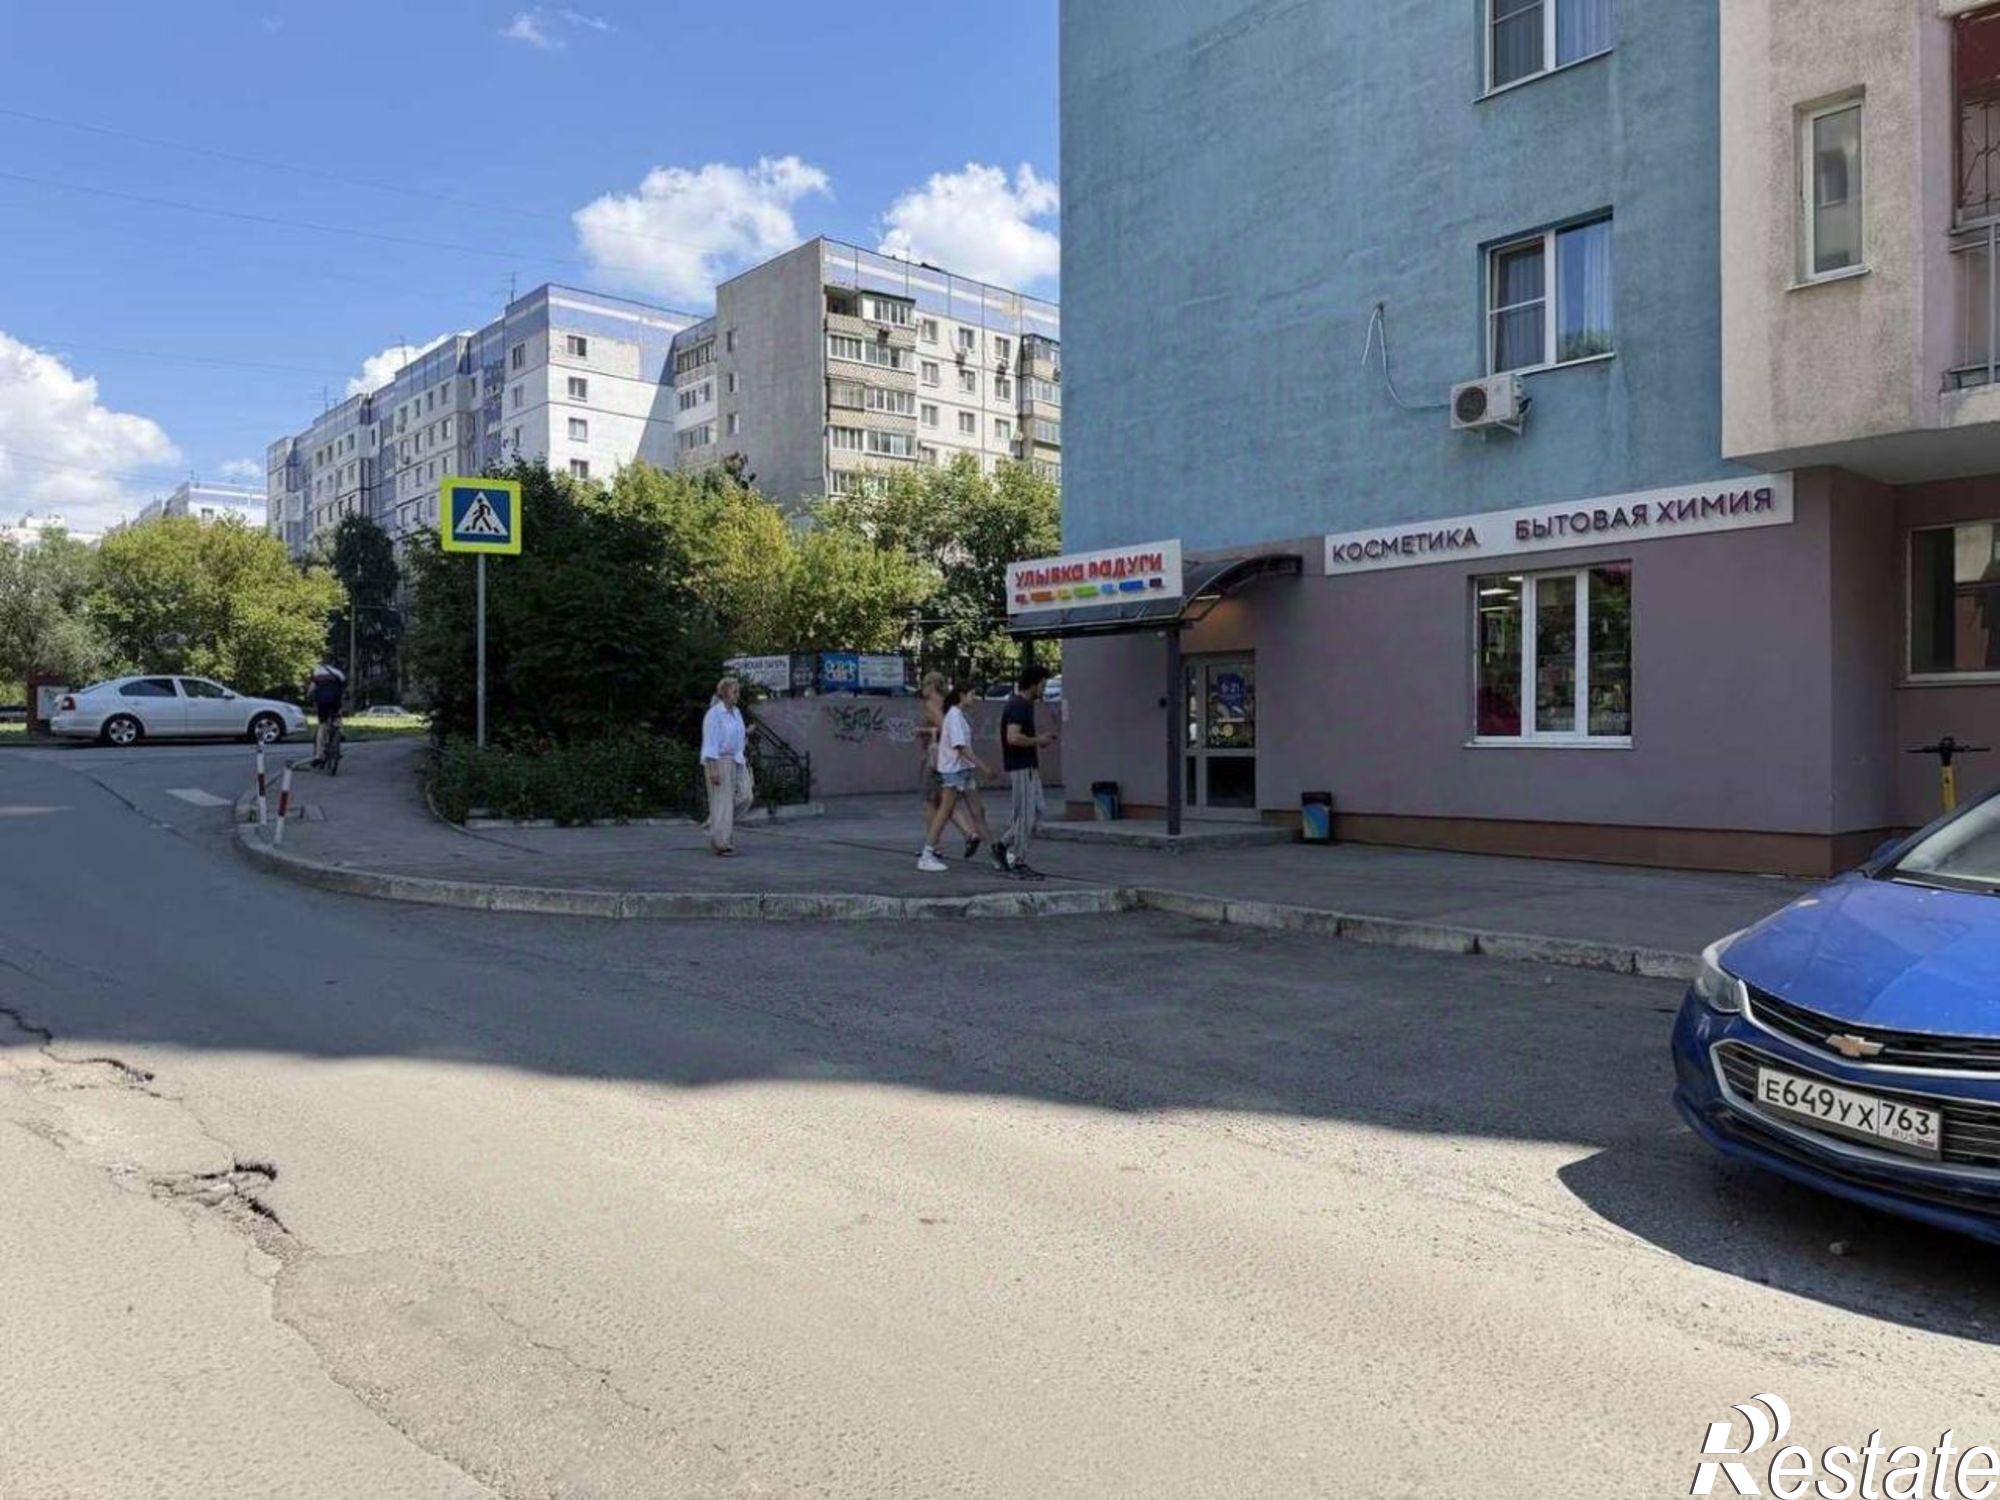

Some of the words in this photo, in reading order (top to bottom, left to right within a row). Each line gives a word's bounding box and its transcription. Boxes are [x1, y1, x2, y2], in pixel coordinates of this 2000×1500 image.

[1333, 526, 1479, 562] КОСМЕТИКА
[1515, 504, 1648, 540] БЫТОВАЯ
[1656, 487, 1773, 525] ХИМИЯ
[1882, 1102, 1930, 1135] 763
